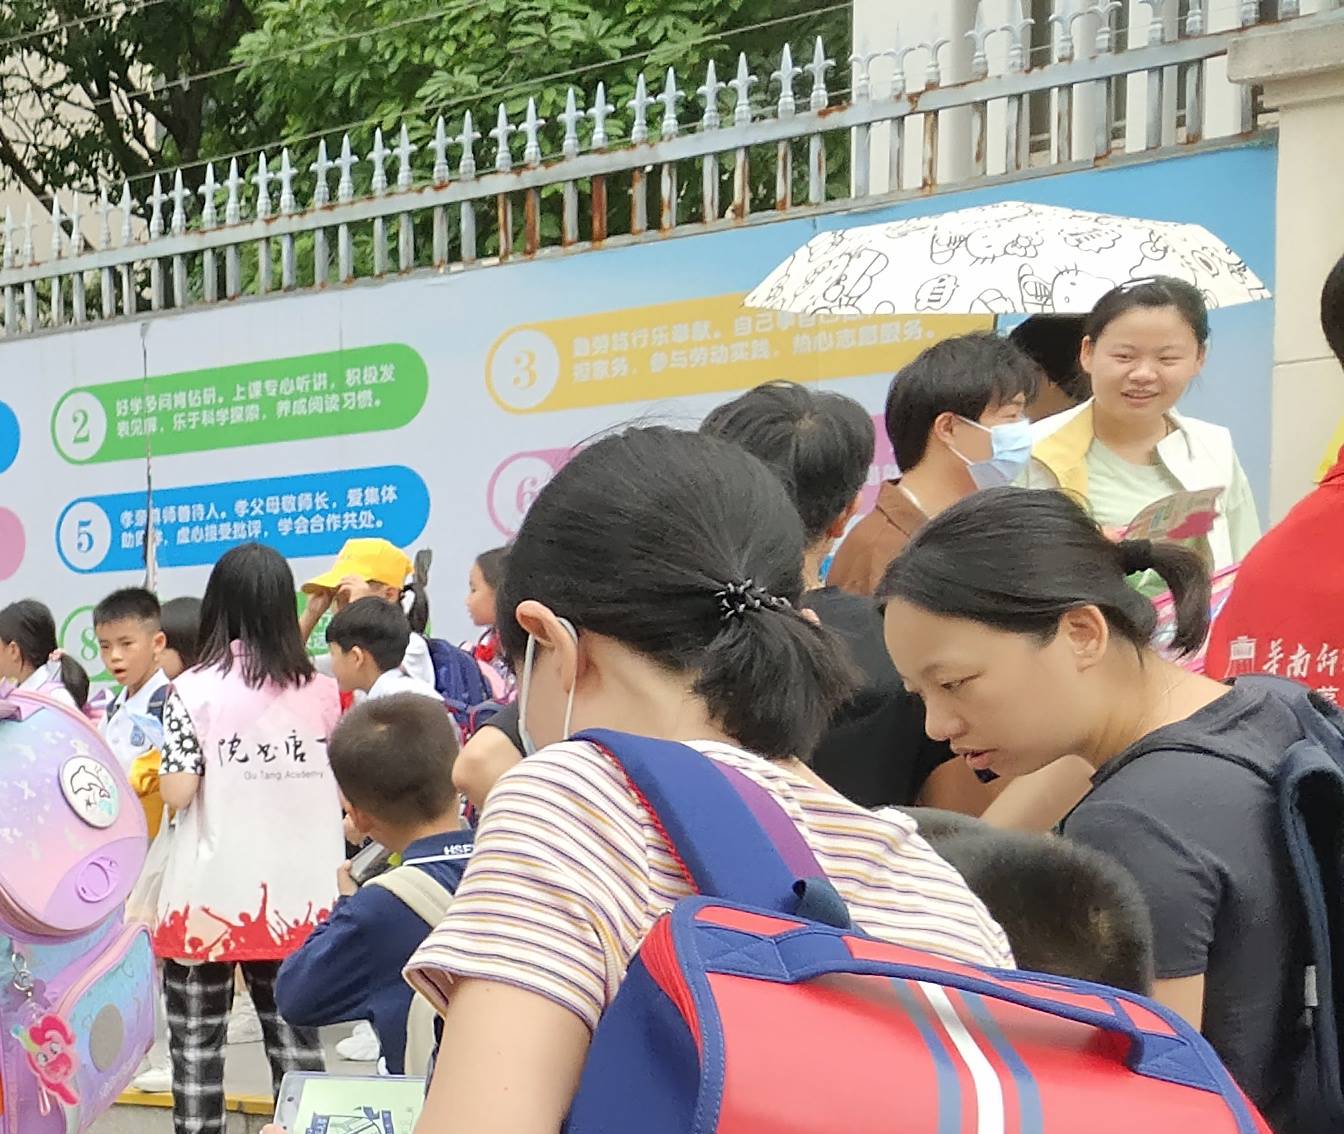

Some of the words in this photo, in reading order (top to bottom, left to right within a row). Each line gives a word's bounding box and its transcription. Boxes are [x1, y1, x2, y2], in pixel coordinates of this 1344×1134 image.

[513, 350, 537, 389] 3
[72, 409, 90, 443] 2
[76, 520, 94, 553] 5
[80, 627, 99, 661] 8
